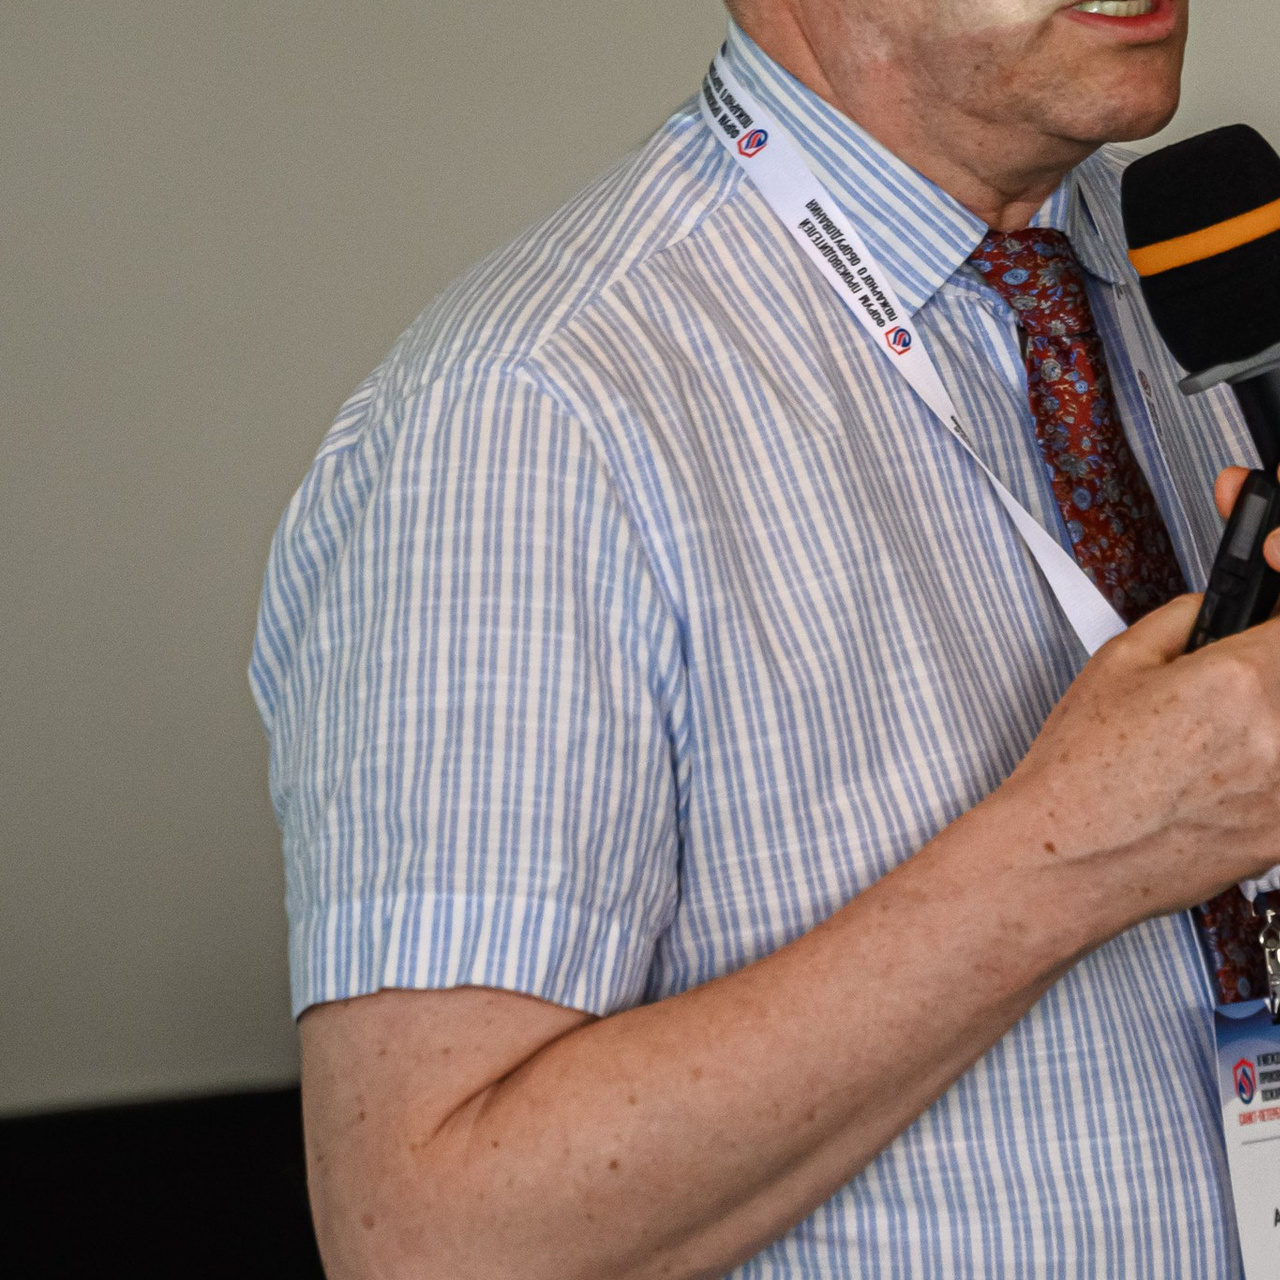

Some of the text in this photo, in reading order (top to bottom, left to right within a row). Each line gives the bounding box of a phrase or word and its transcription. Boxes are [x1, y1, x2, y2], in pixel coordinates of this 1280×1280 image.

[798, 218, 886, 328] ФОРУМ ПРОИЗВОДИТЕЛЕЙ
[805, 198, 898, 322] ПОЖАРНОГО ОБОРУДОВАНИЯ
